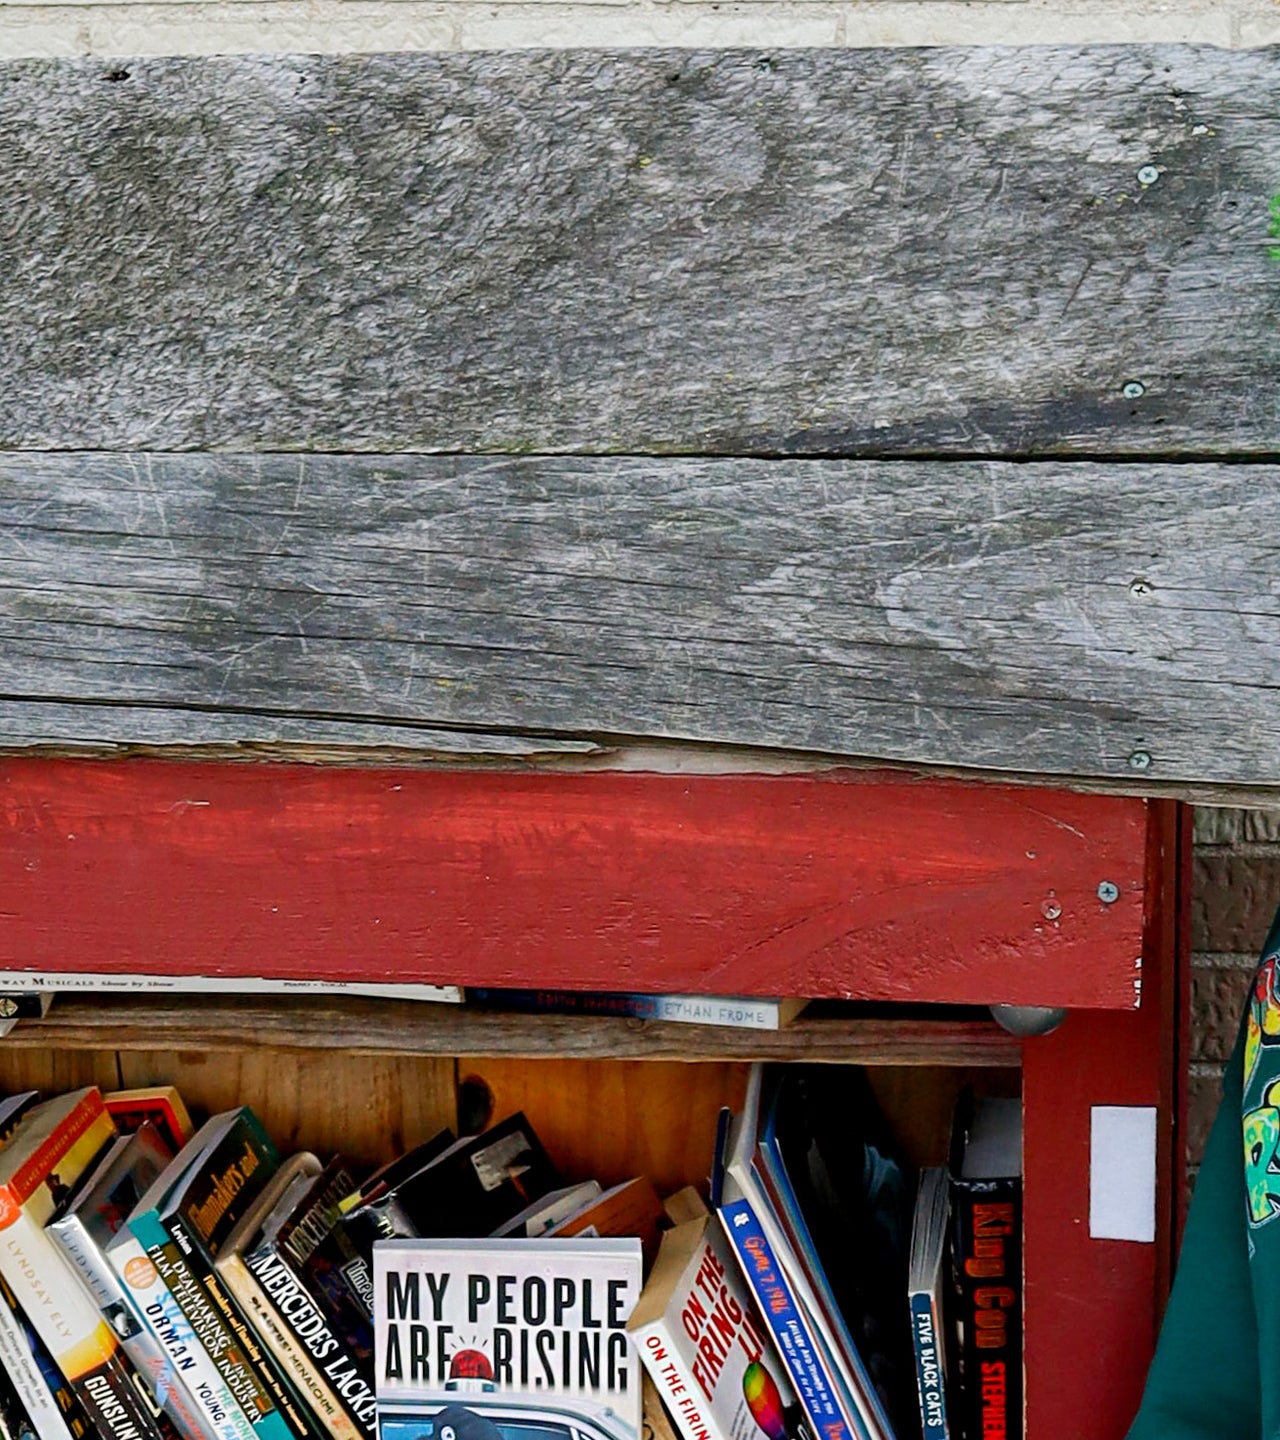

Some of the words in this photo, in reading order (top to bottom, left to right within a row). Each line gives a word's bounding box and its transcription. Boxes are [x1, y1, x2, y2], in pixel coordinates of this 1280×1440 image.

[31, 976, 94, 987] MUSICALS
[663, 1002, 713, 1020] ETHAN
[718, 1009, 765, 1024] FROME
[169, 1223, 196, 1256] Levison
[961, 1202, 1016, 1278] King
[5, 1239, 54, 1308] LYNDSAY
[166, 1259, 235, 1350] DEALMAKING
[386, 1271, 451, 1321] MY
[467, 1273, 629, 1329] PEOPLE
[141, 1300, 200, 1374] ORMAN
[145, 1243, 176, 1279] FILM
[165, 1280, 228, 1361] TELEVISION
[213, 1357, 267, 1428] INDUSTRY
[252, 1254, 340, 1375] MERCEDES
[691, 1285, 743, 1403] FIRING
[915, 1312, 934, 1344] FIVE
[972, 1285, 1017, 1349] Con
[287, 1351, 335, 1418] MENAECHMI
[385, 1323, 454, 1383] ARE
[492, 1327, 628, 1392] RISING
[644, 1333, 669, 1362] ON
[659, 1361, 686, 1398] THE
[918, 1347, 939, 1388] BLACK
[923, 1391, 943, 1427] CATS
